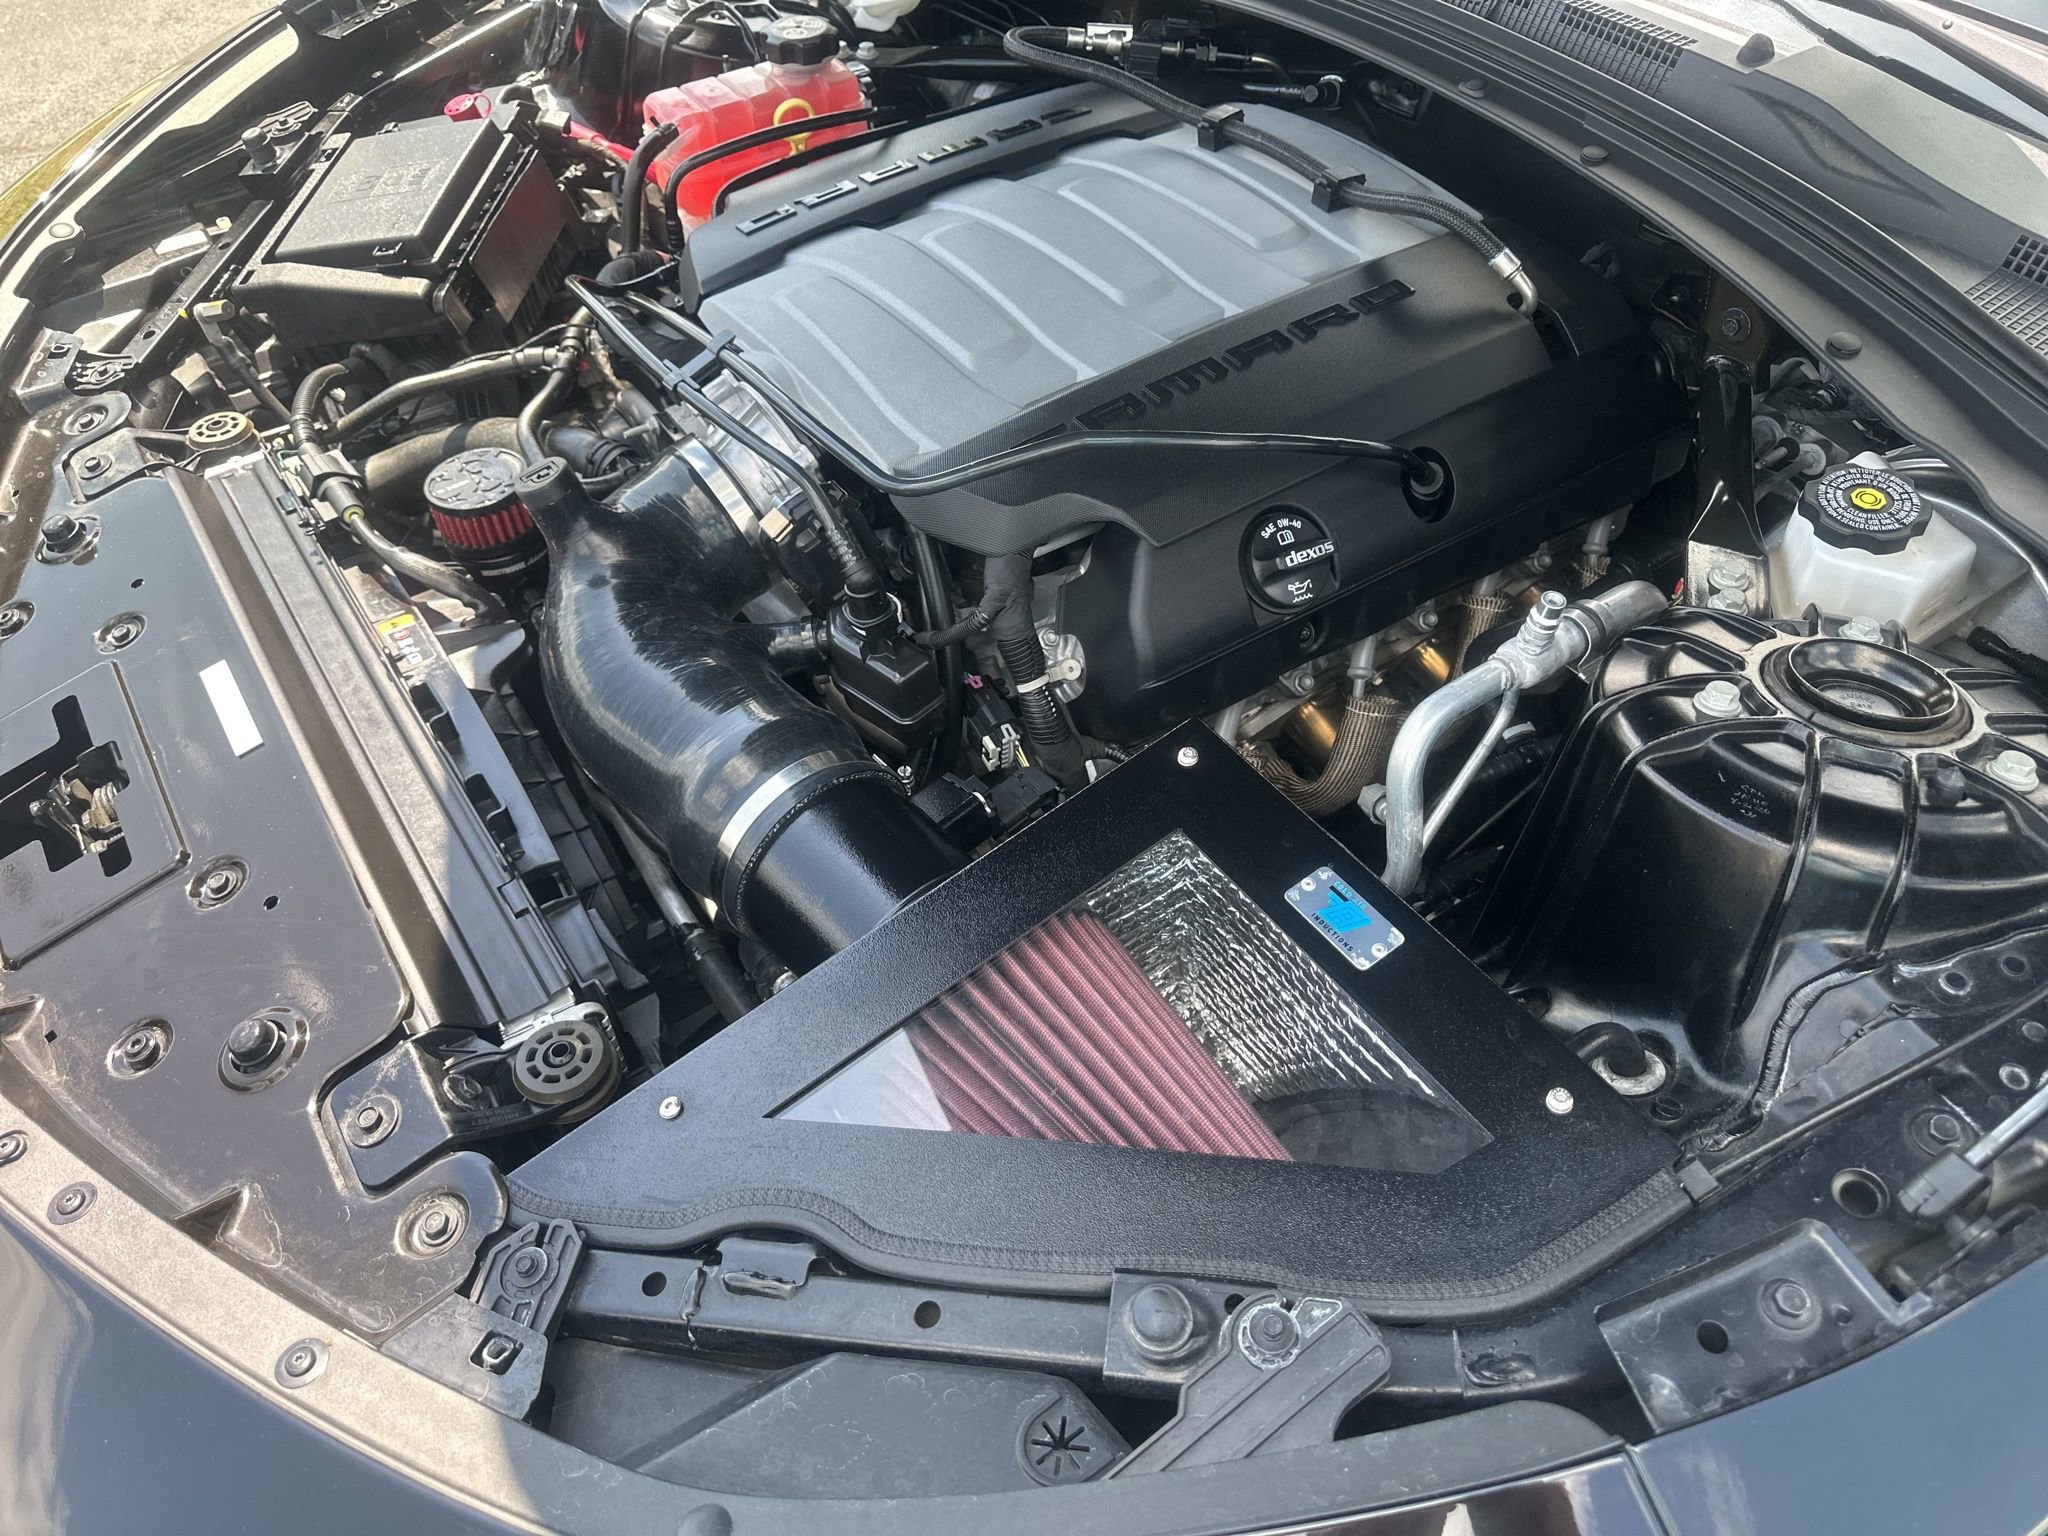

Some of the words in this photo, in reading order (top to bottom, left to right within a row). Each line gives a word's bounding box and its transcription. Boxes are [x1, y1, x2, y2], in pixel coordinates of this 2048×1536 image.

[1008, 278, 1416, 449] AMARO
[1261, 523, 1277, 539] SAE
[1277, 518, 1302, 529] 0W-40
[1285, 541, 1335, 567] dexos
[1334, 880, 1353, 898] COLD
[1311, 912, 1354, 952] INDUCTIONS
